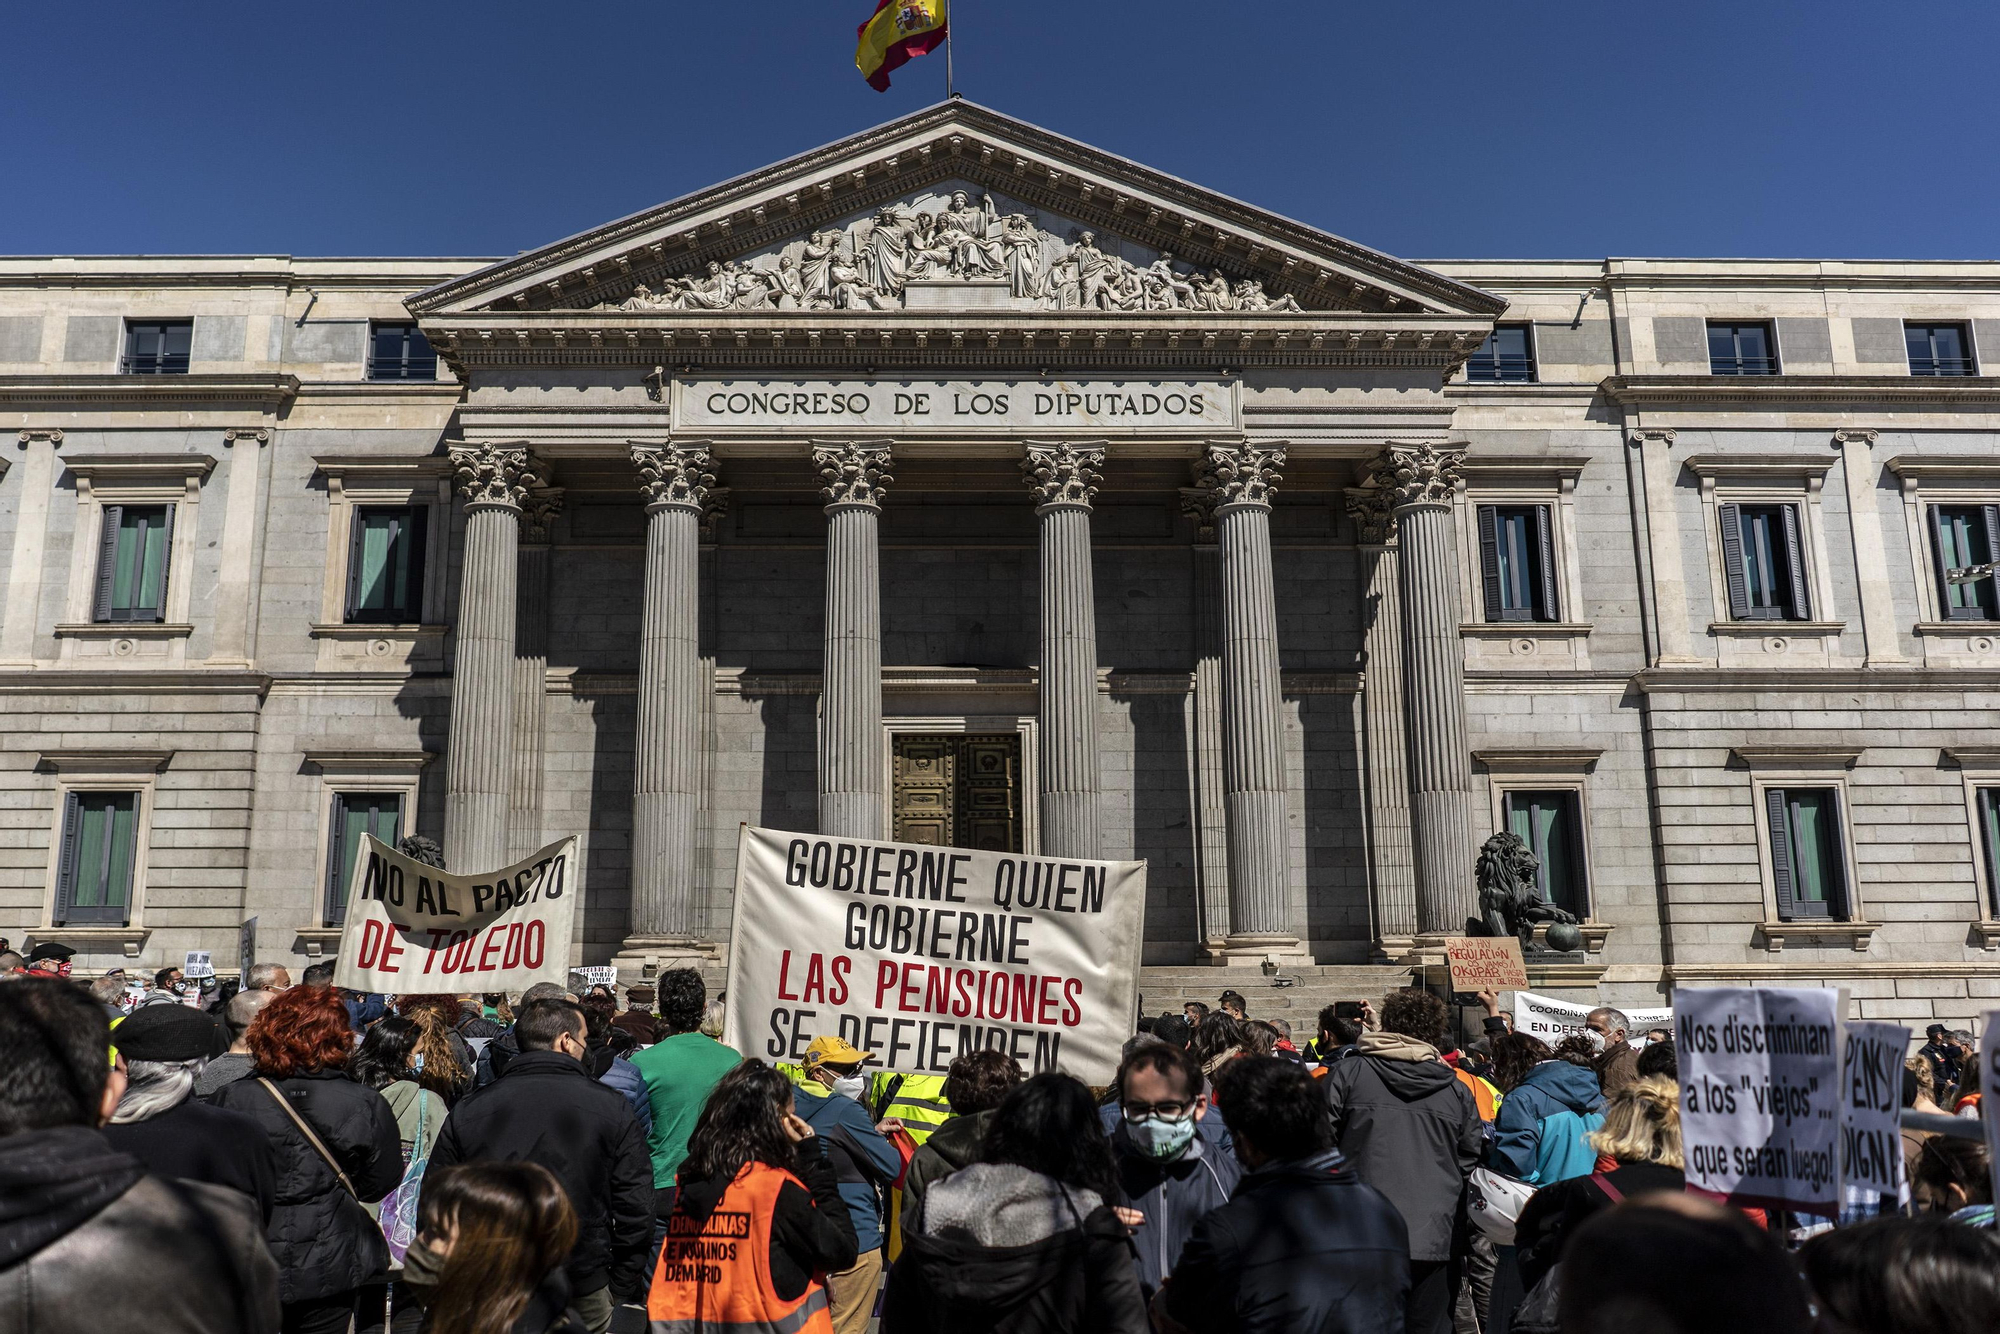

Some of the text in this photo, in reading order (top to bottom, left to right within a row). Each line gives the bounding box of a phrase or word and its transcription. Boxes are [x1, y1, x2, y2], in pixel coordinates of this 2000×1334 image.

[707, 392, 1205, 414] CONGRESO DE LOS DIPUTADOS
[362, 852, 566, 916] NO AL PACTO
[786, 839, 1106, 913] GOBIERNE QUIEN
[357, 919, 545, 975] DE TOLEDO
[845, 902, 1033, 965] GOBIERNE
[1449, 947, 1509, 960] REGULACIÓN
[1477, 939, 1491, 948] HAY
[1452, 966, 1524, 978] OKUPAR HASTA
[1484, 960, 1508, 968] VAMOS
[1510, 960, 1516, 968] A
[1508, 978, 1526, 986] PERRO
[778, 949, 1083, 1027] LAS PENSIONES
[767, 1008, 1061, 1075] SE DEFIENDEN
[1532, 1022, 1549, 1033] EN
[1681, 1014, 1830, 1055] Nos discriminan
[1687, 1086, 1700, 1112] a
[1704, 1074, 1736, 1114] los
[1693, 1137, 1834, 1194] que serán luego!
